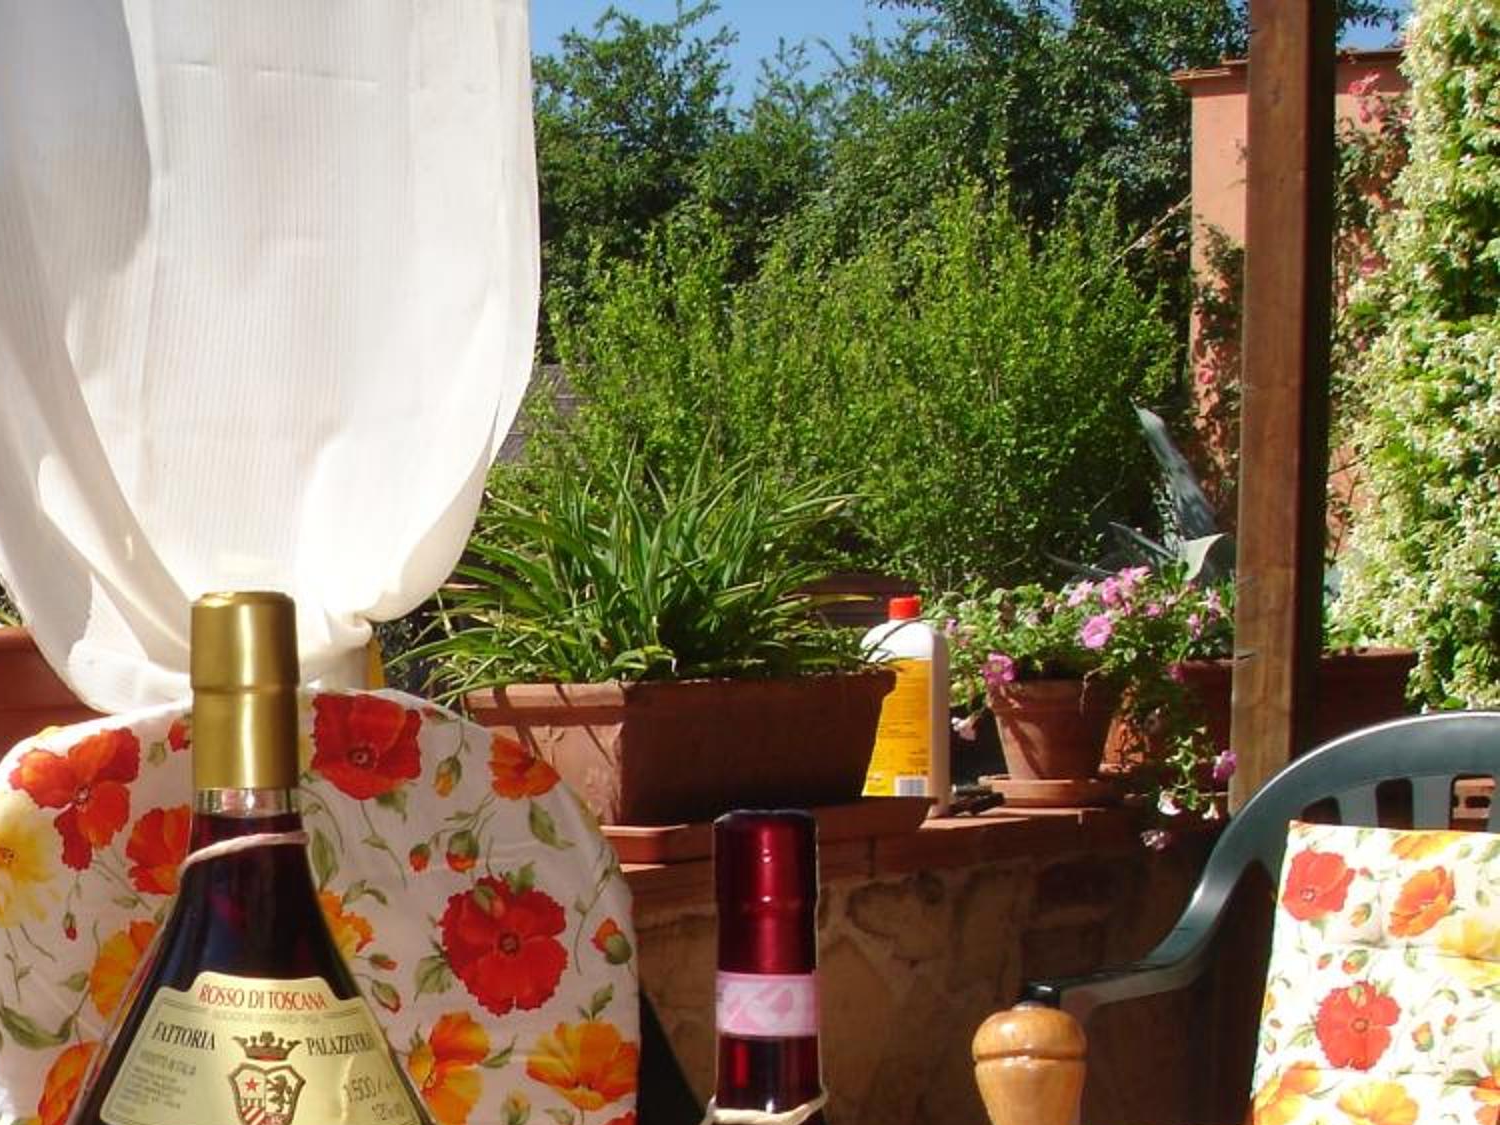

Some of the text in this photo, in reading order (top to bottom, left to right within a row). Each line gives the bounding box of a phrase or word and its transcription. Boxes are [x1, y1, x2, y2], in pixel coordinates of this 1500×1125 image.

[198, 983, 329, 1011] ROSSO DI TOSCANA
[151, 1021, 215, 1051] FATTORIA
